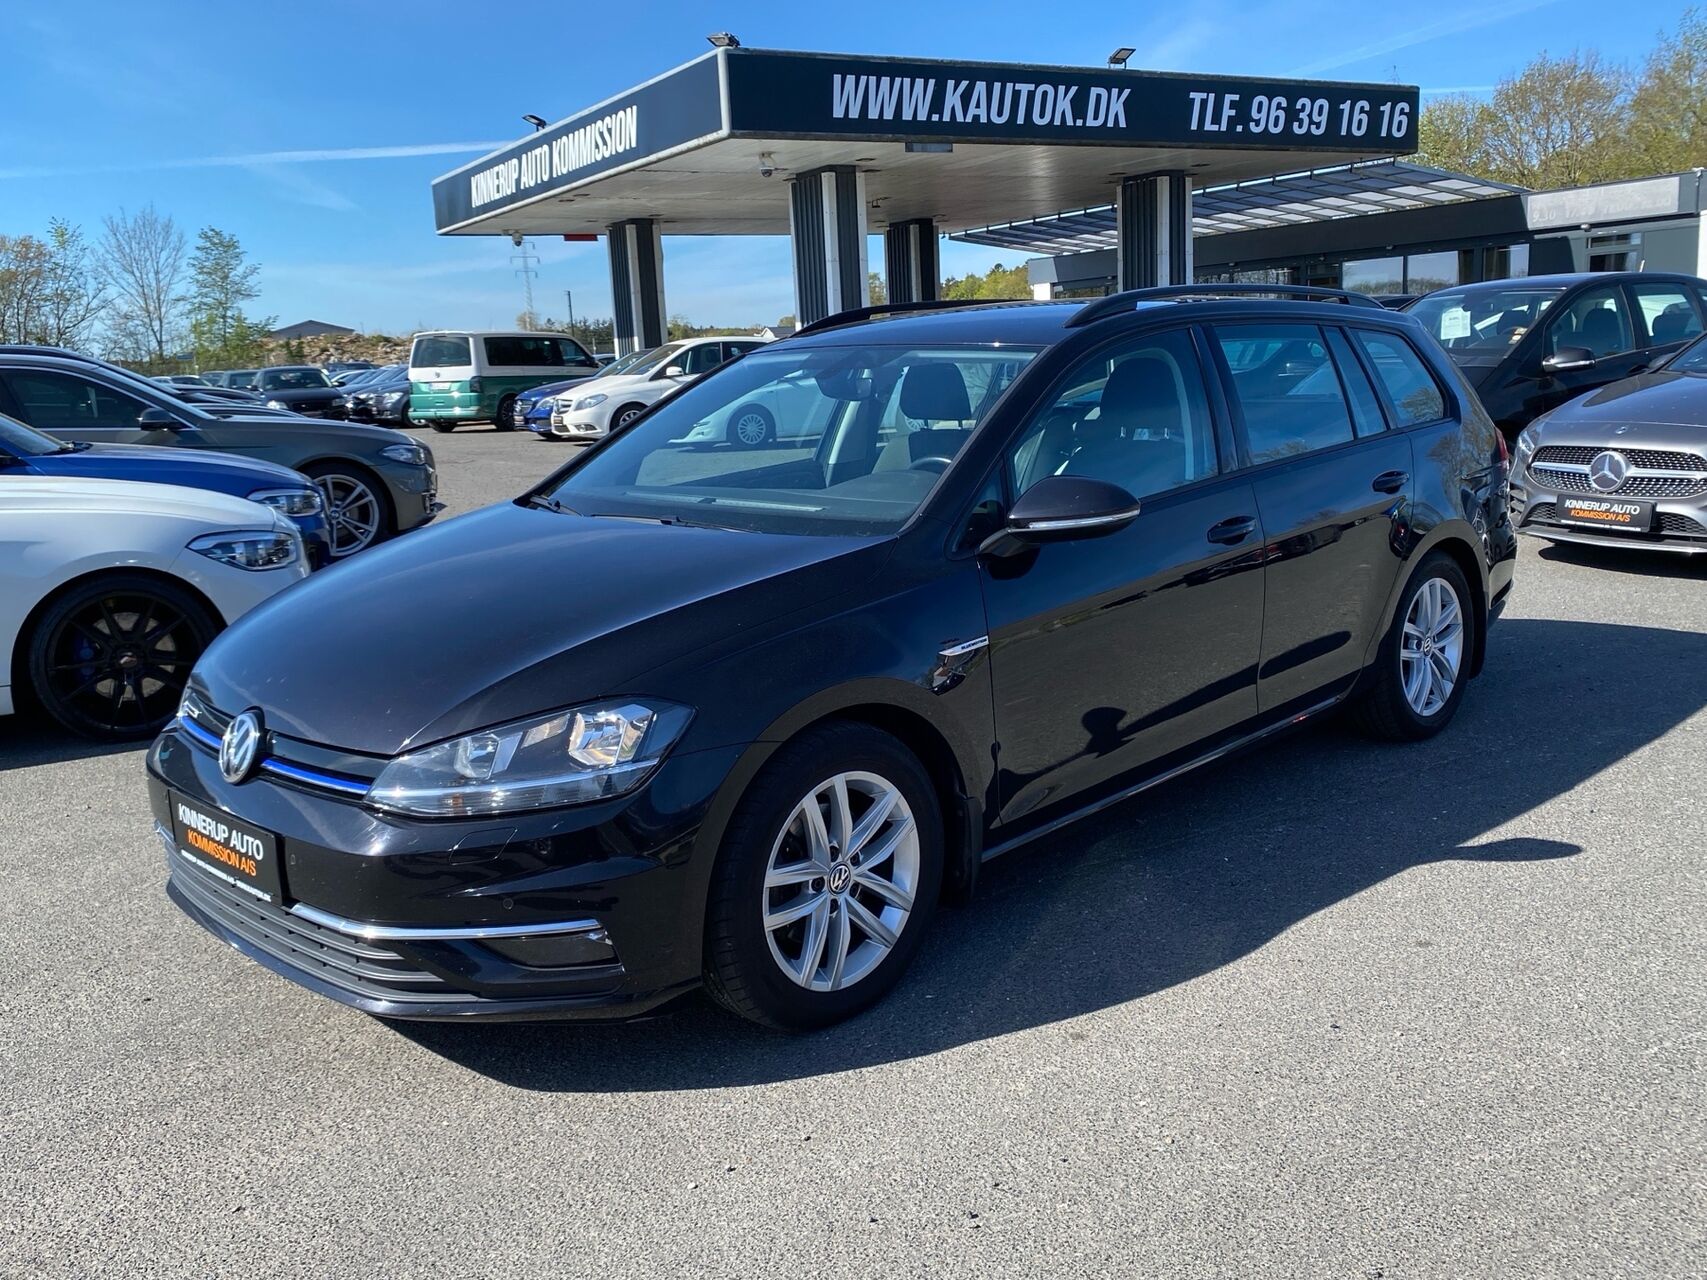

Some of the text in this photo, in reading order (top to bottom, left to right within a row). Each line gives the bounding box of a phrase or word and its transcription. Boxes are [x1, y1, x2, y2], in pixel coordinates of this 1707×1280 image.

[832, 74, 1131, 128] WWW.KAUTOK.DK
[1189, 92, 1411, 138] TLF. 96 39 16 16
[471, 105, 637, 208] KINNERUP AUTO KOMMISSION
[1564, 499, 1640, 515] KINNERUP AUTO
[1570, 510, 1631, 522] KOMMISSION A/S
[178, 802, 264, 861] KINNERUP AUTO
[187, 829, 240, 868] KOMMISSION
[240, 856, 257, 876] A/S
